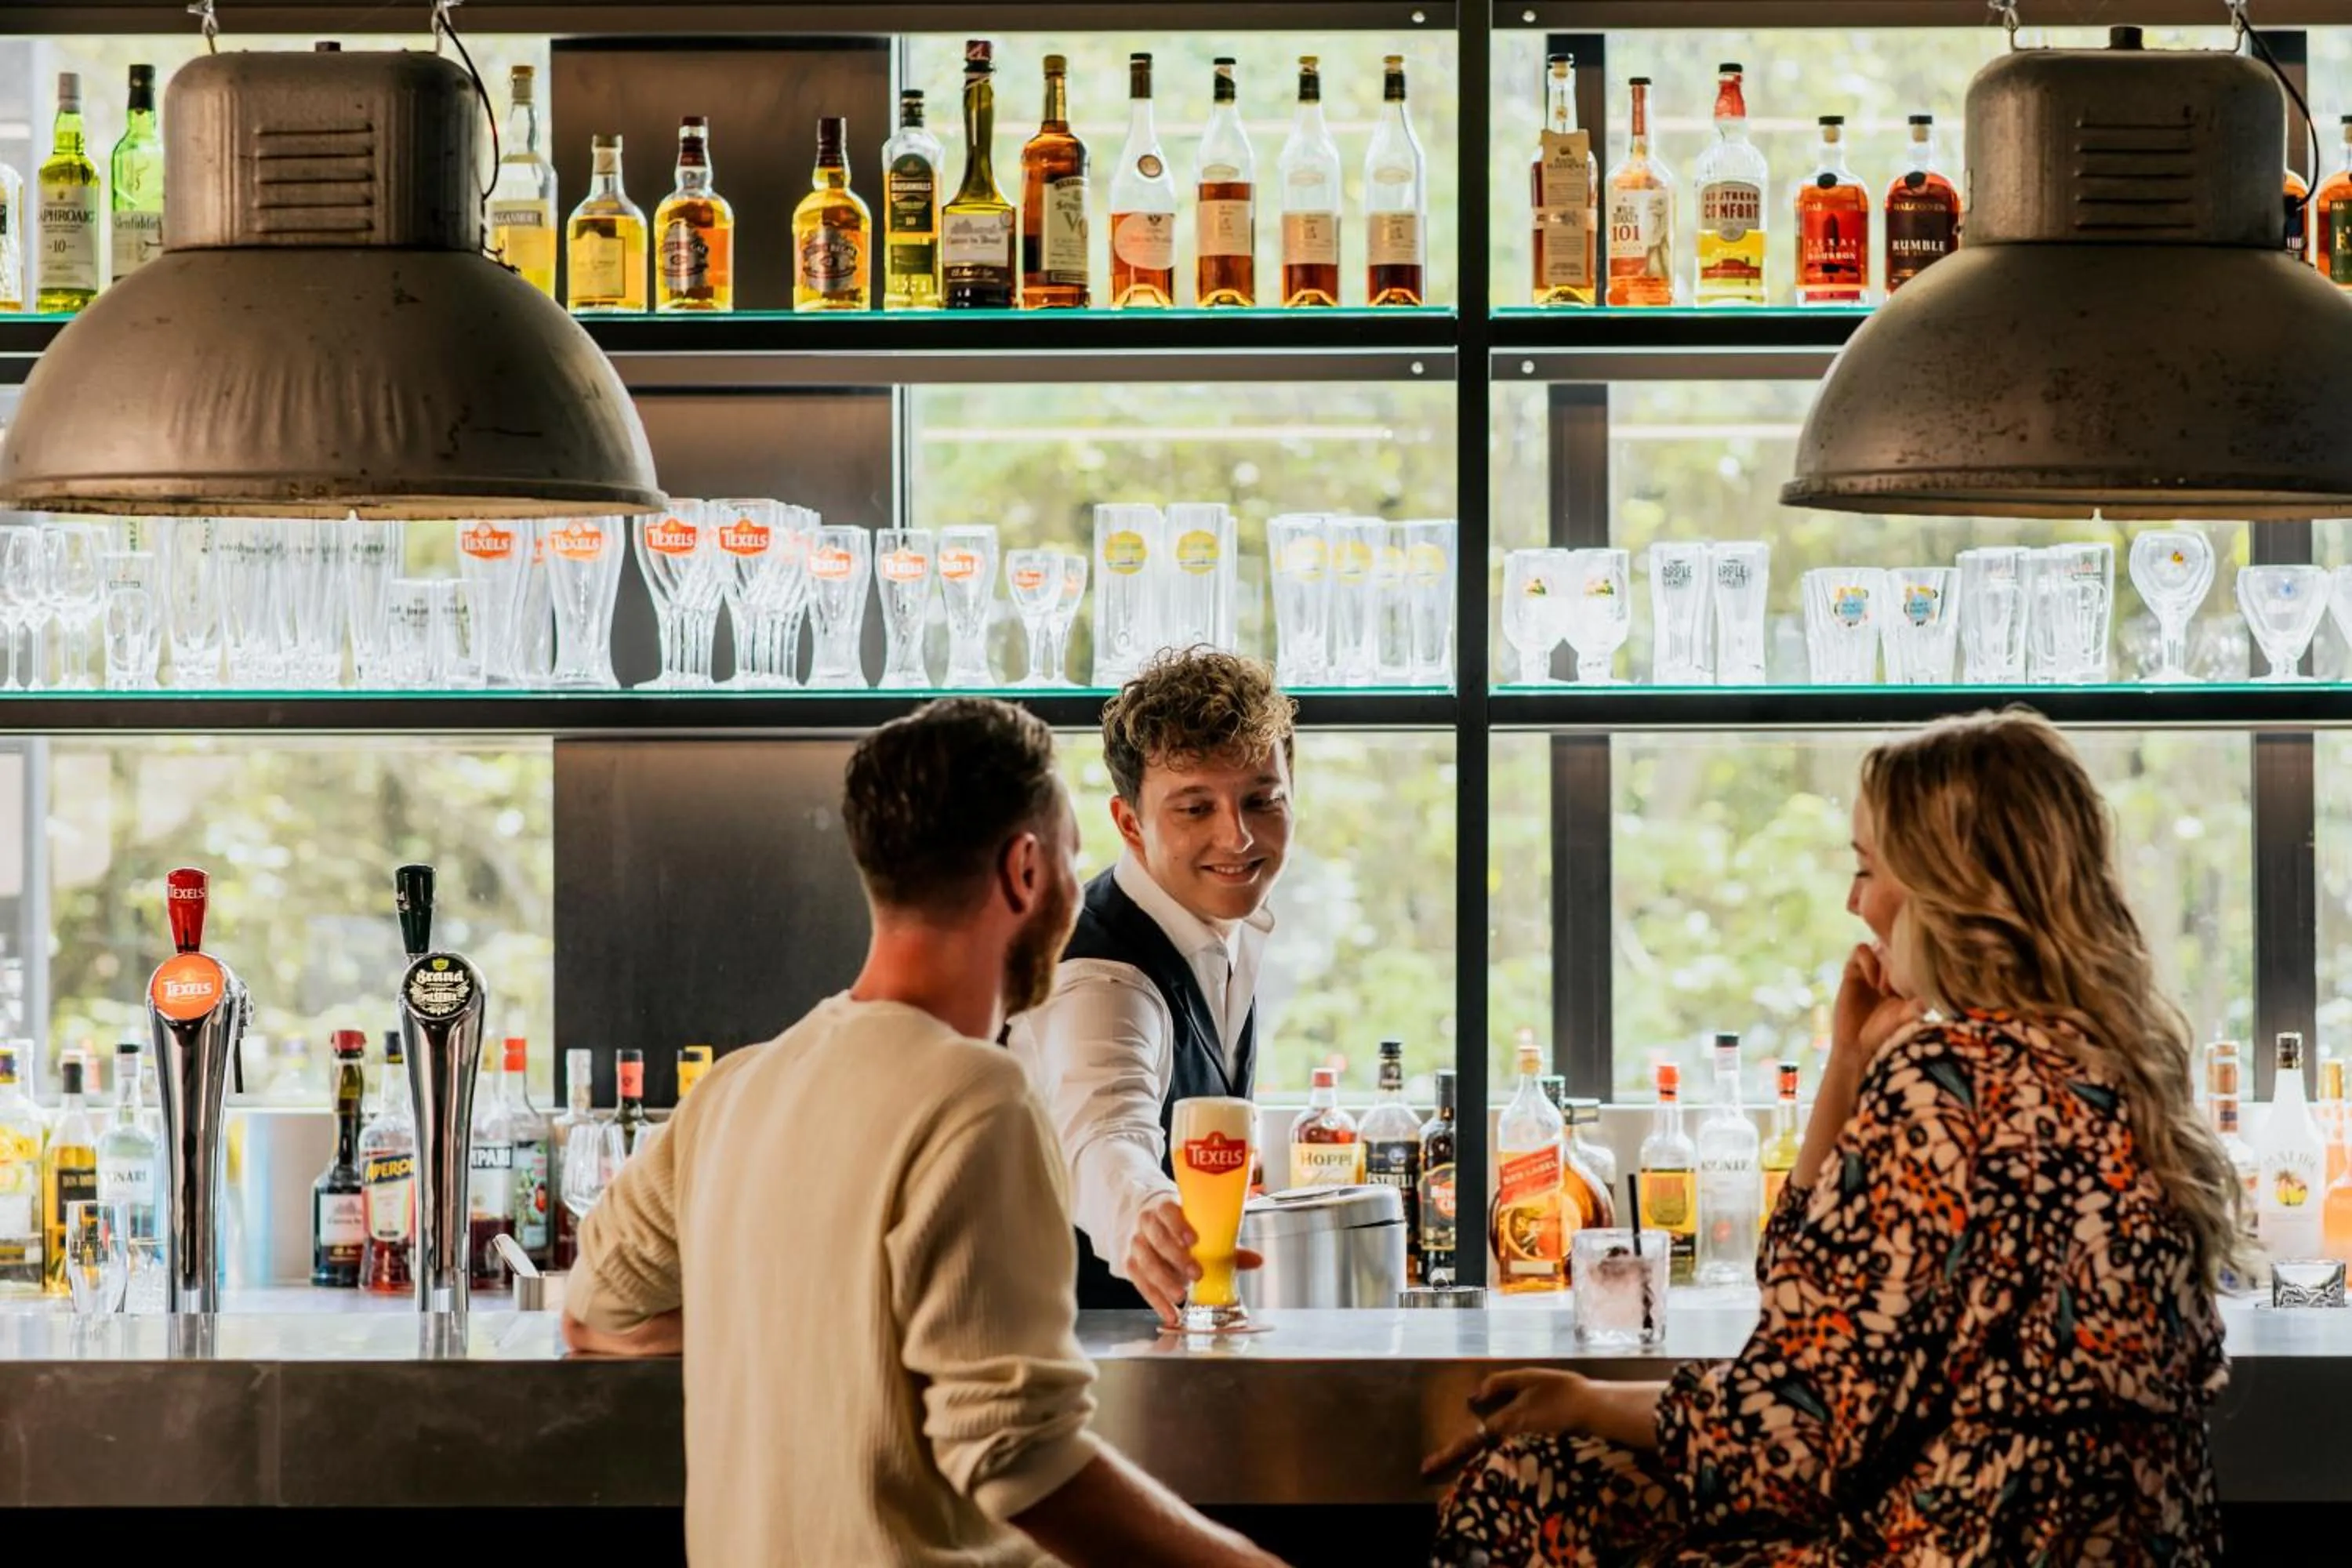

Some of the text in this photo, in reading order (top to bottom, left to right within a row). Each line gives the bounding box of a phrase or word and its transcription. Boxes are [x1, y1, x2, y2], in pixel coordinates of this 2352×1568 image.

[40, 209, 94, 223] APHROAIG
[1613, 226, 1639, 241] 101
[53, 239, 67, 252] 10
[1893, 240, 1945, 252] RUMBLE
[463, 532, 510, 550] TEXELS
[648, 527, 695, 546] TEXELS
[720, 527, 768, 547] TEXELS
[168, 884, 205, 899] TEXELS
[416, 969, 464, 985] Brand
[163, 981, 212, 1000] TEXELS
[470, 1149, 511, 1167] MPARI
[1188, 1145, 1243, 1166] TEXELS
